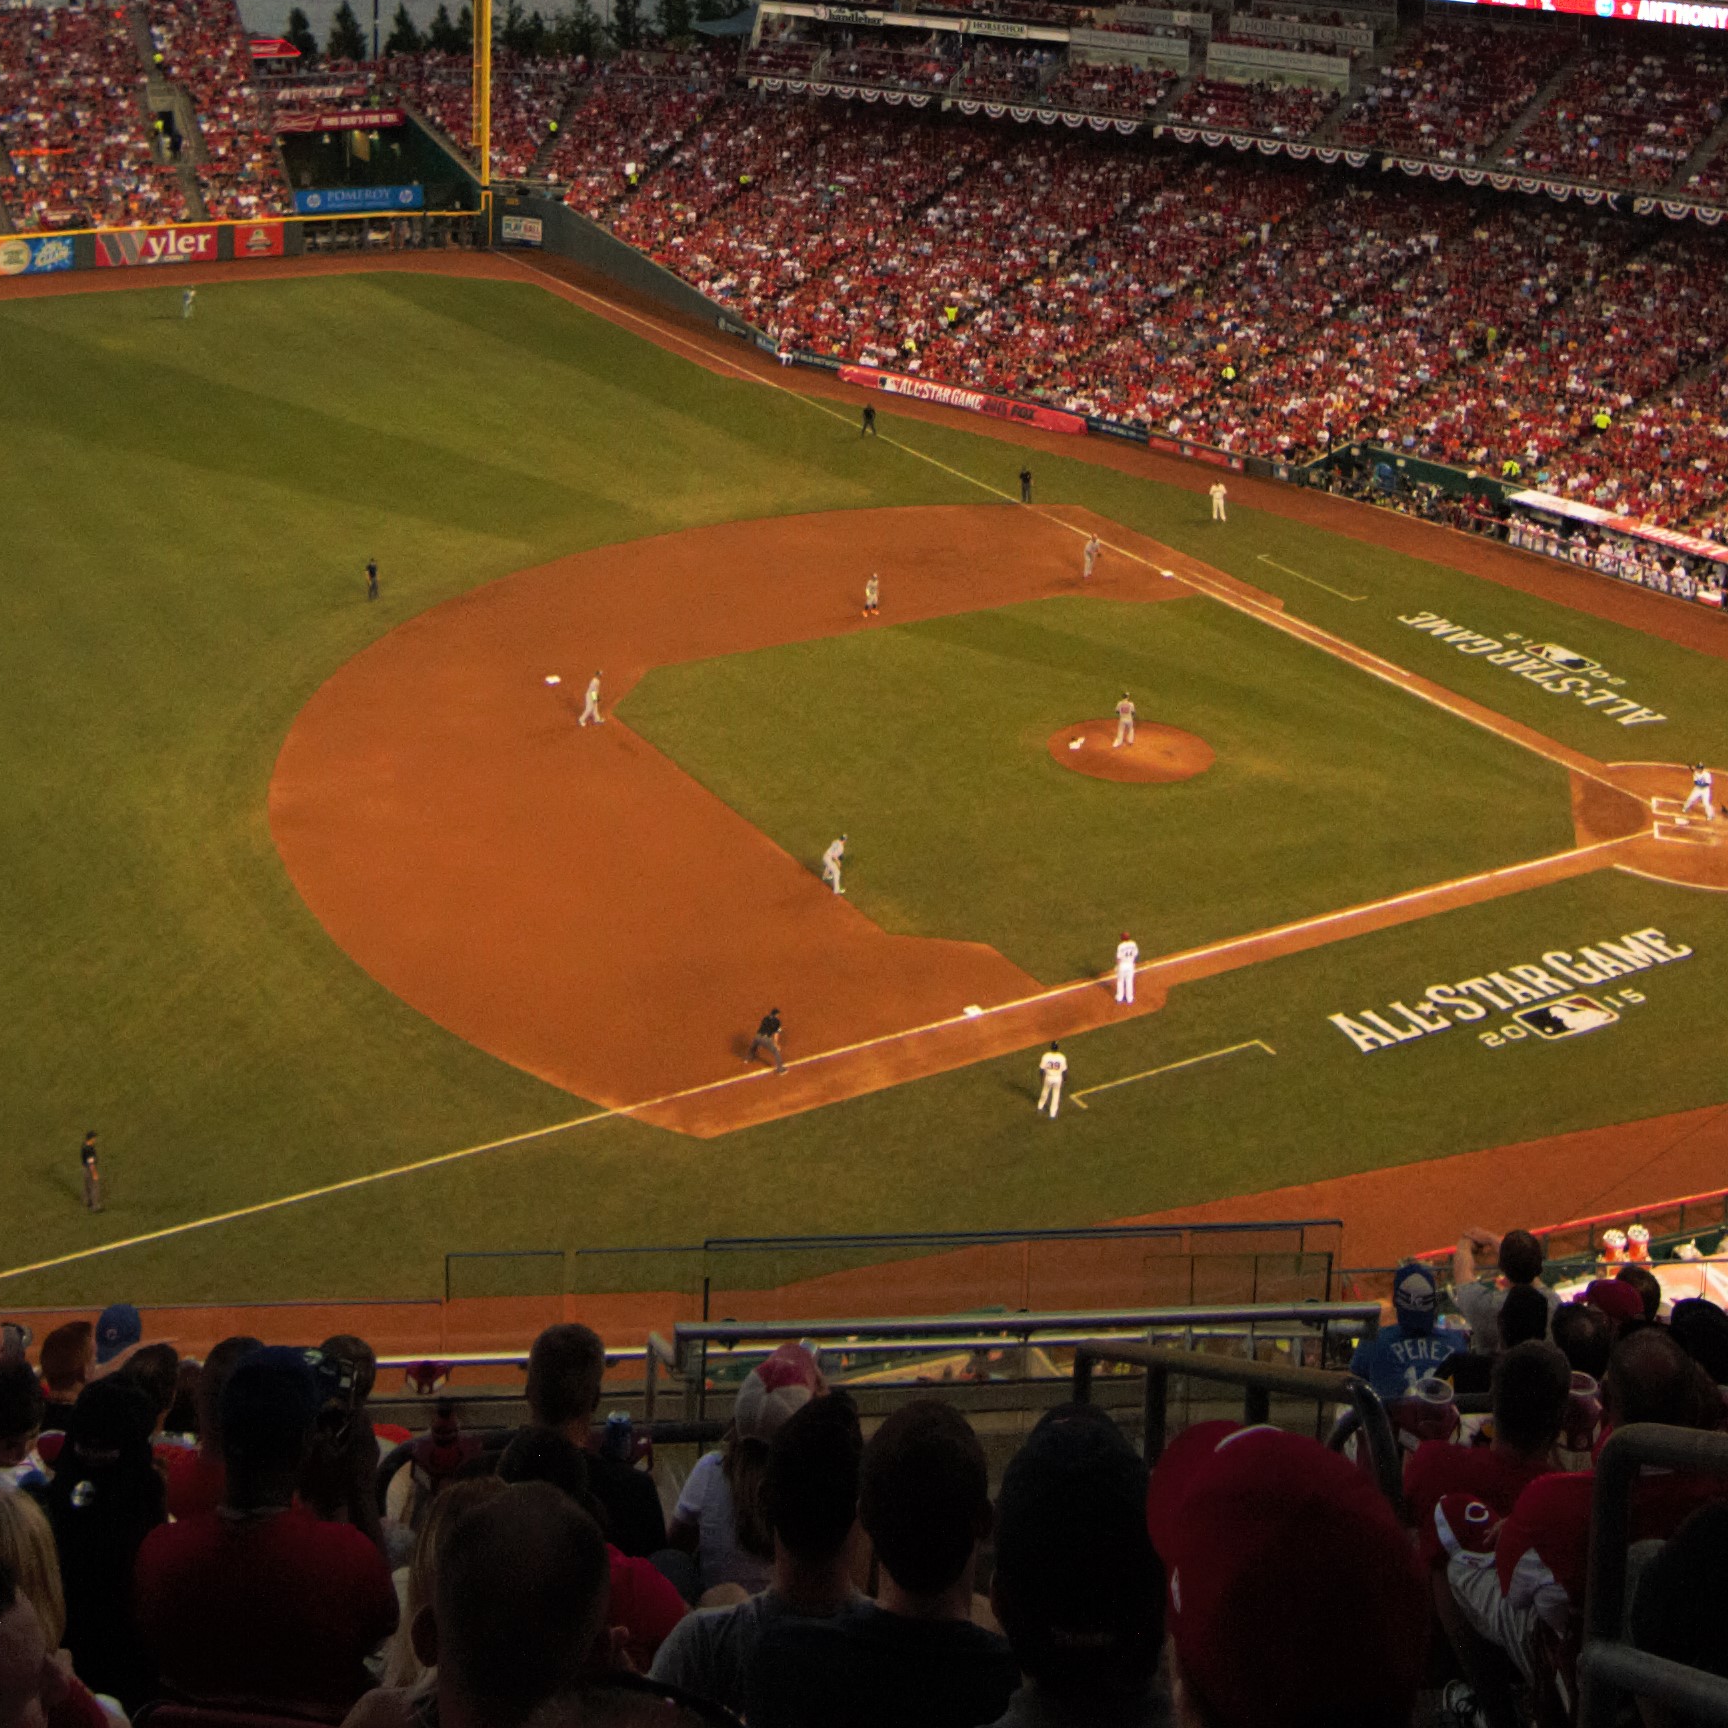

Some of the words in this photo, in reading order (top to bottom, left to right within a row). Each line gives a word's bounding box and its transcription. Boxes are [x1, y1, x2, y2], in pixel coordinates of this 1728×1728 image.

[326, 188, 391, 202] POMEROY
[898, 377, 922, 397] ALL
[921, 381, 952, 403] STAR
[950, 388, 985, 411] GAME
[1010, 404, 1036, 421] FOX
[1397, 610, 1504, 654] GAME
[1486, 648, 1591, 695] STAR
[1581, 688, 1668, 727] ALL
[1327, 1000, 1453, 1055] ALL
[1425, 962, 1575, 1022] STAR
[1542, 926, 1695, 986] GAME
[1046, 1060, 1061, 1071] 39
[1389, 1338, 1456, 1364] PEREZ
